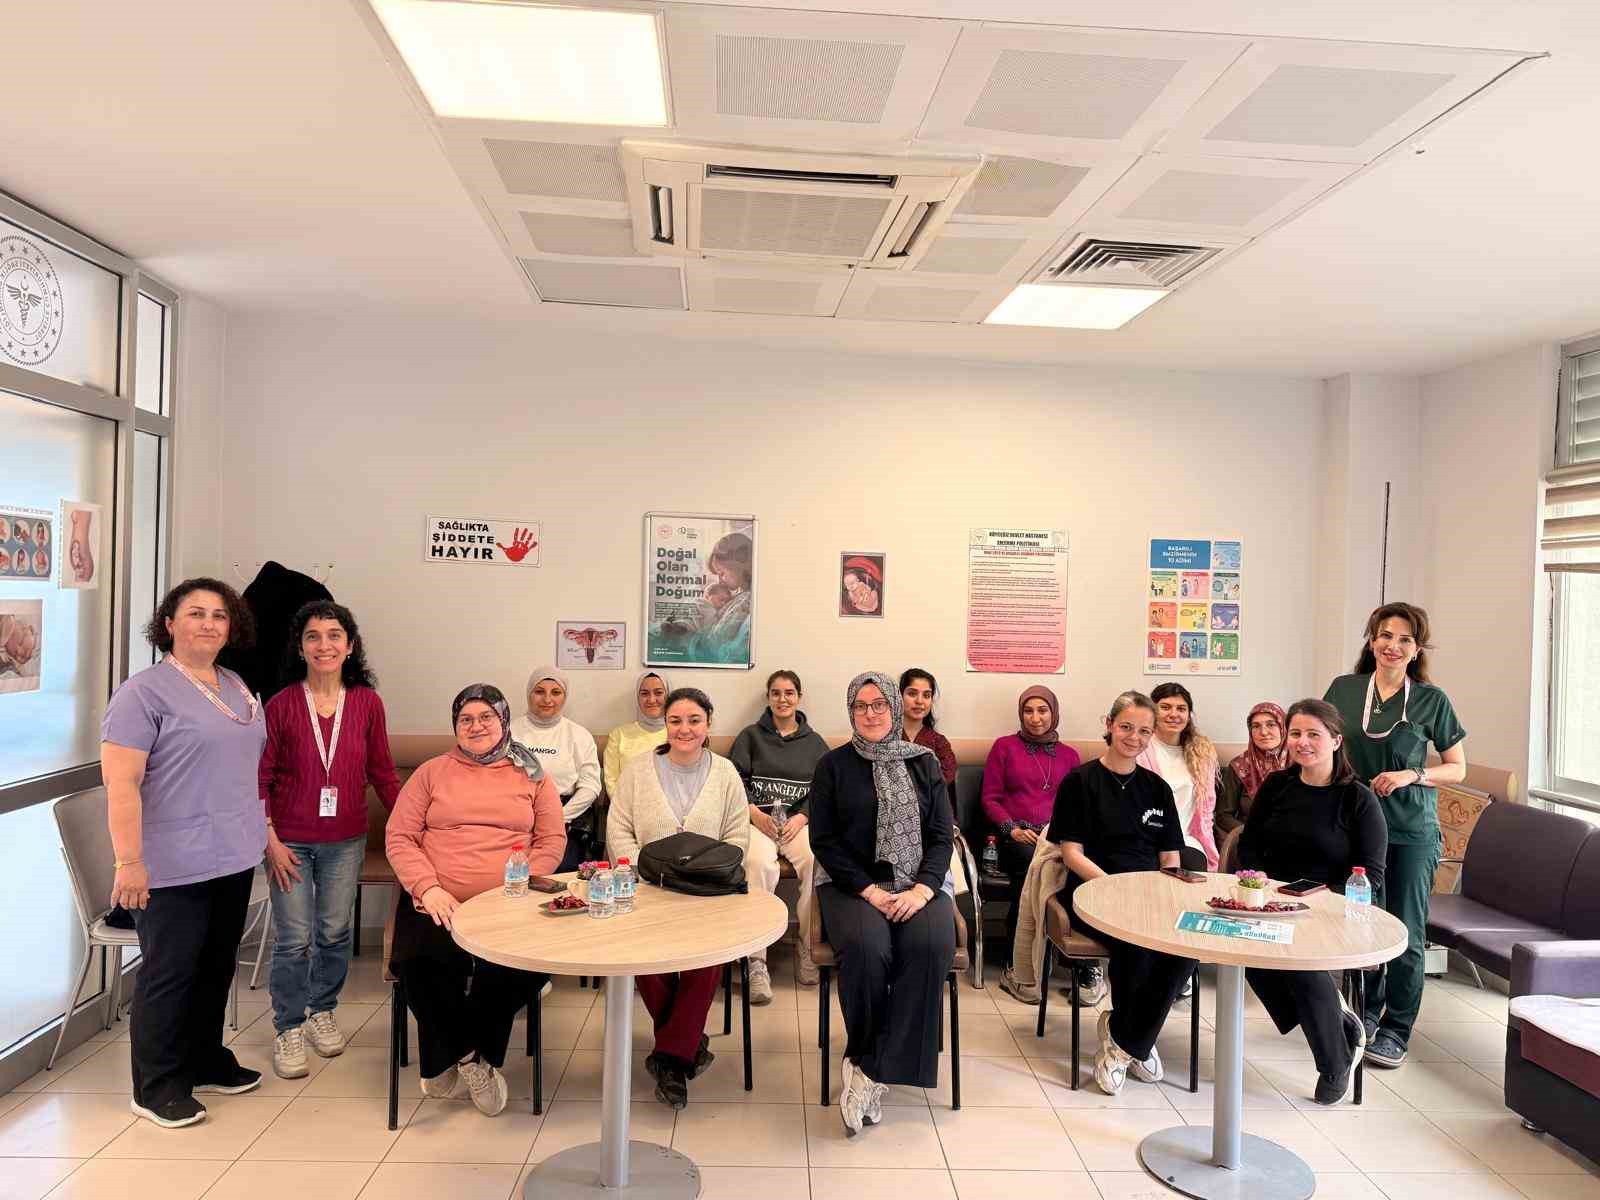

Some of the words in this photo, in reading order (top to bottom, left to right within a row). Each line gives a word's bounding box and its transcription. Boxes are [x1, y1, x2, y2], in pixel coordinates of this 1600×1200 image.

[438, 521, 489, 532] SAĞLIKTA
[432, 532, 494, 544] ŞİDDETE
[431, 545, 494, 560] HAYIR
[656, 547, 697, 561] Doğal
[656, 560, 688, 572] Olan
[656, 573, 707, 585] Normal
[655, 585, 705, 600] Doğum
